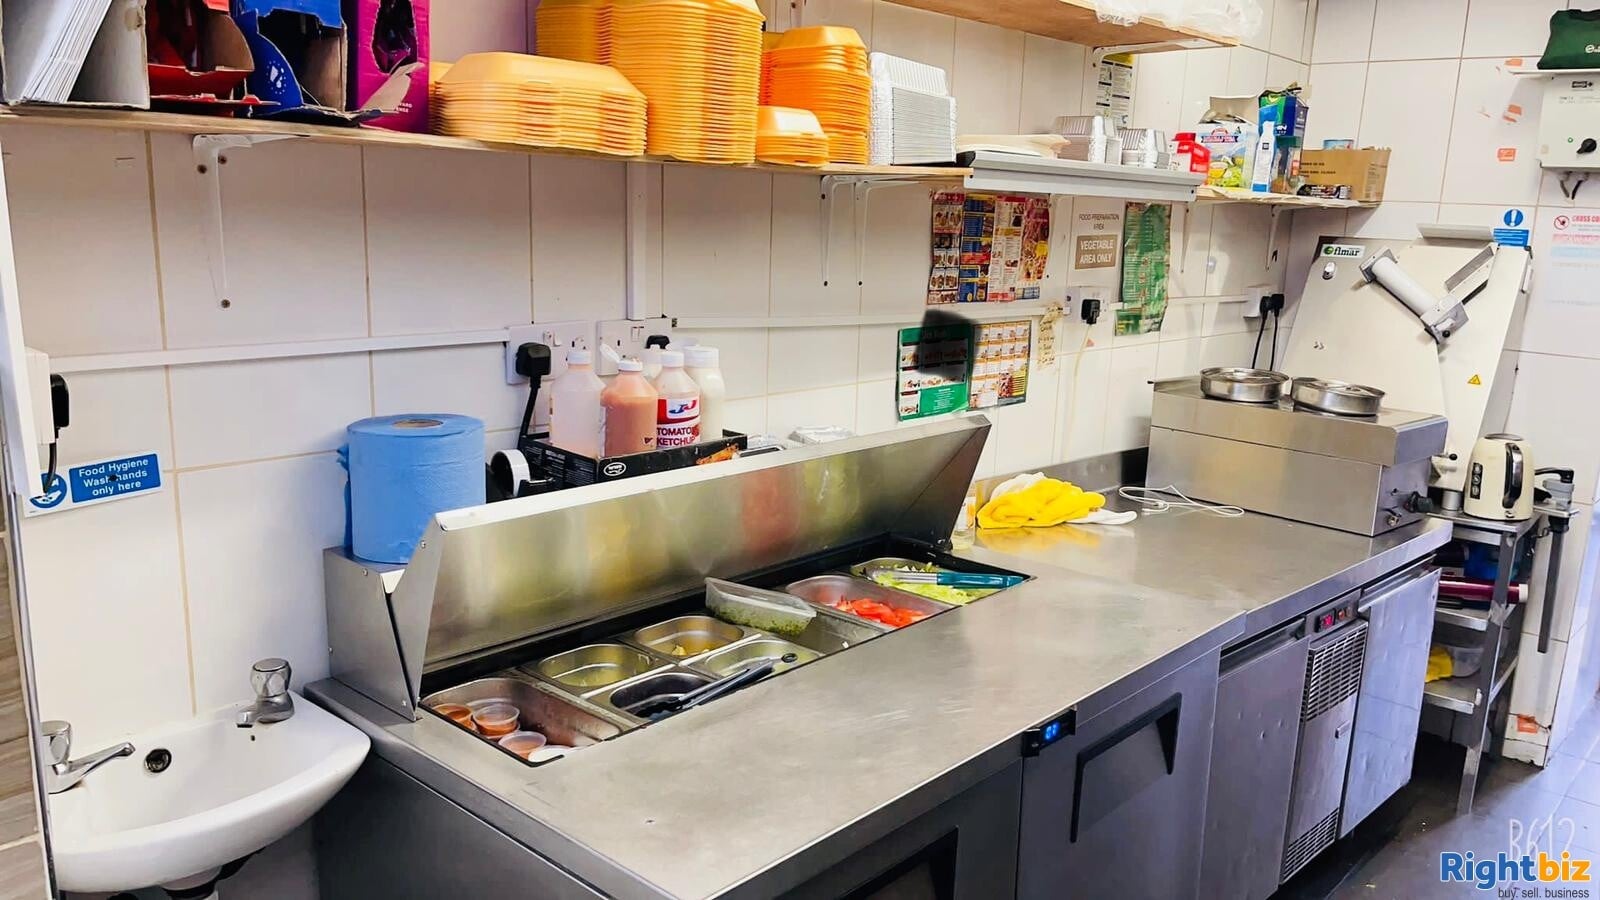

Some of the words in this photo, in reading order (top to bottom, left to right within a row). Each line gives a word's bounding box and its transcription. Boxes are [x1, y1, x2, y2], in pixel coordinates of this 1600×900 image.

[1080, 239, 1114, 250] VEGETABLE
[1079, 254, 1096, 264] AREA
[1097, 253, 1113, 263] ONLY
[657, 426, 693, 436] TOMATO
[78, 465, 105, 477] Food
[108, 458, 149, 472] Hygiene
[115, 469, 148, 482] hands
[92, 484, 114, 496] only
[117, 480, 142, 491] here
